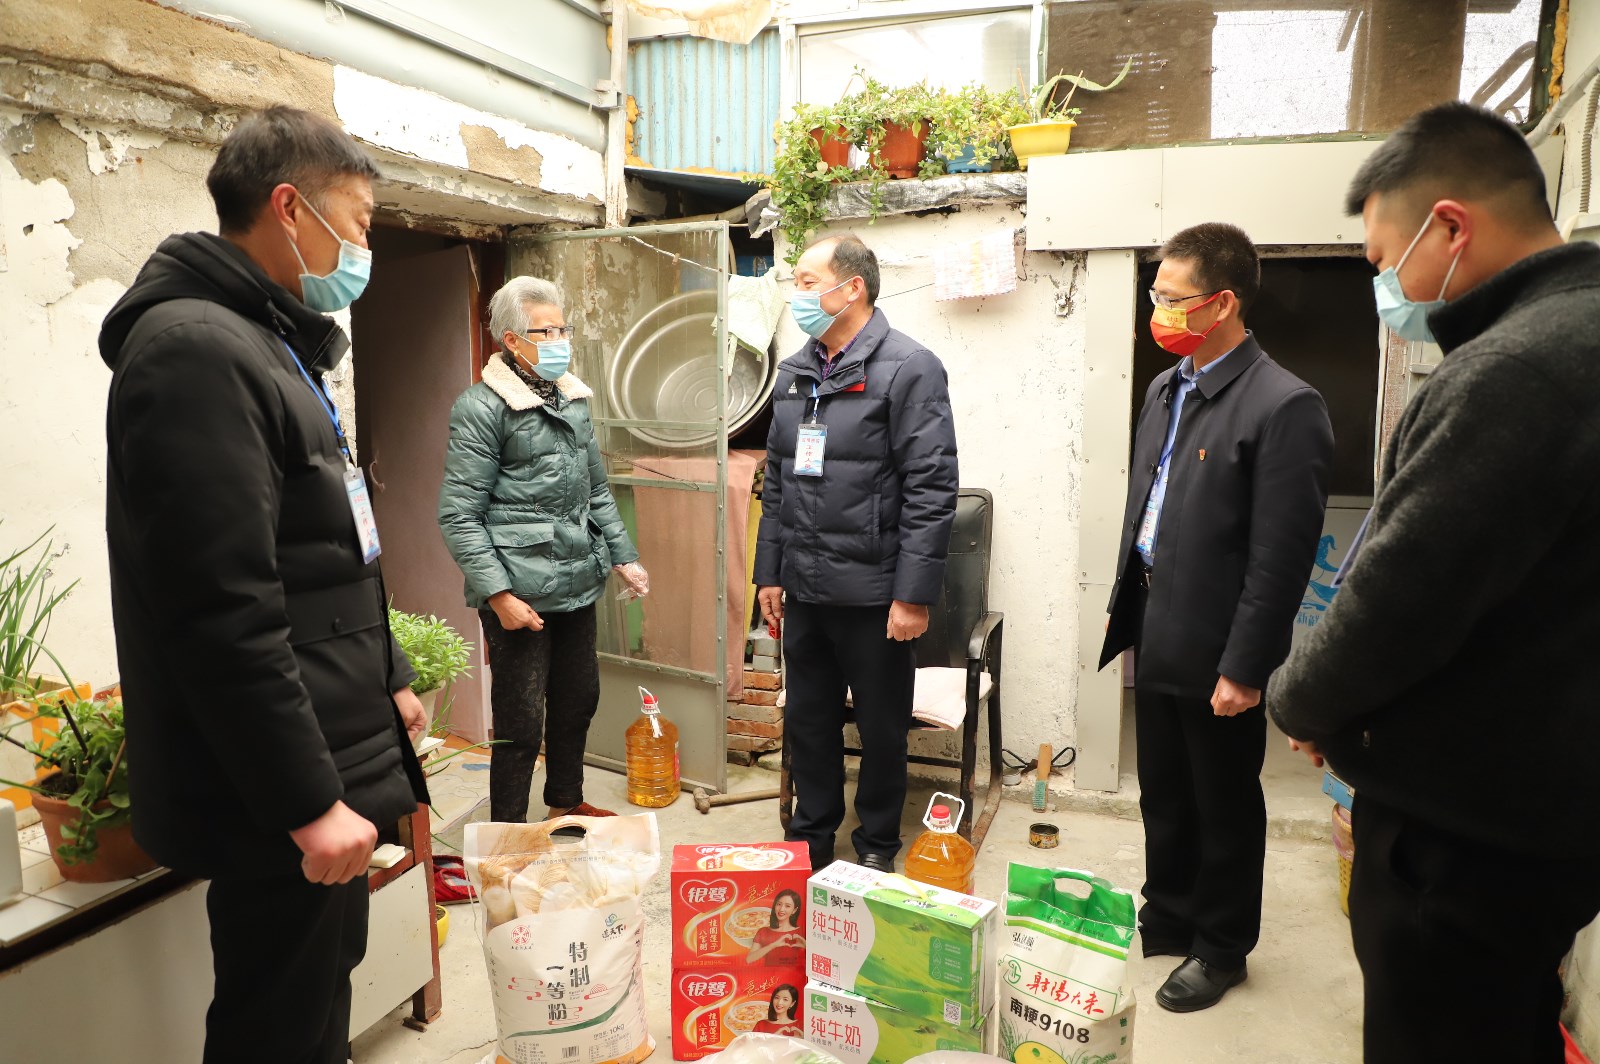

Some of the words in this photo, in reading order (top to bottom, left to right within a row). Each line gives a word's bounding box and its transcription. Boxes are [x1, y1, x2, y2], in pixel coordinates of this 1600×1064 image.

[688, 887, 728, 903] 银鹭
[830, 894, 856, 913] 蒙牛
[812, 910, 859, 944] 纯牛奶
[569, 941, 590, 988] 特制
[813, 960, 830, 975] 3.2g
[546, 966, 568, 1020] 一等粉
[687, 982, 727, 997] 银鹭
[830, 1001, 857, 1018] 蒙牛
[1010, 996, 1090, 1044] 南粳9108
[811, 1015, 861, 1048] 纯牛奶
